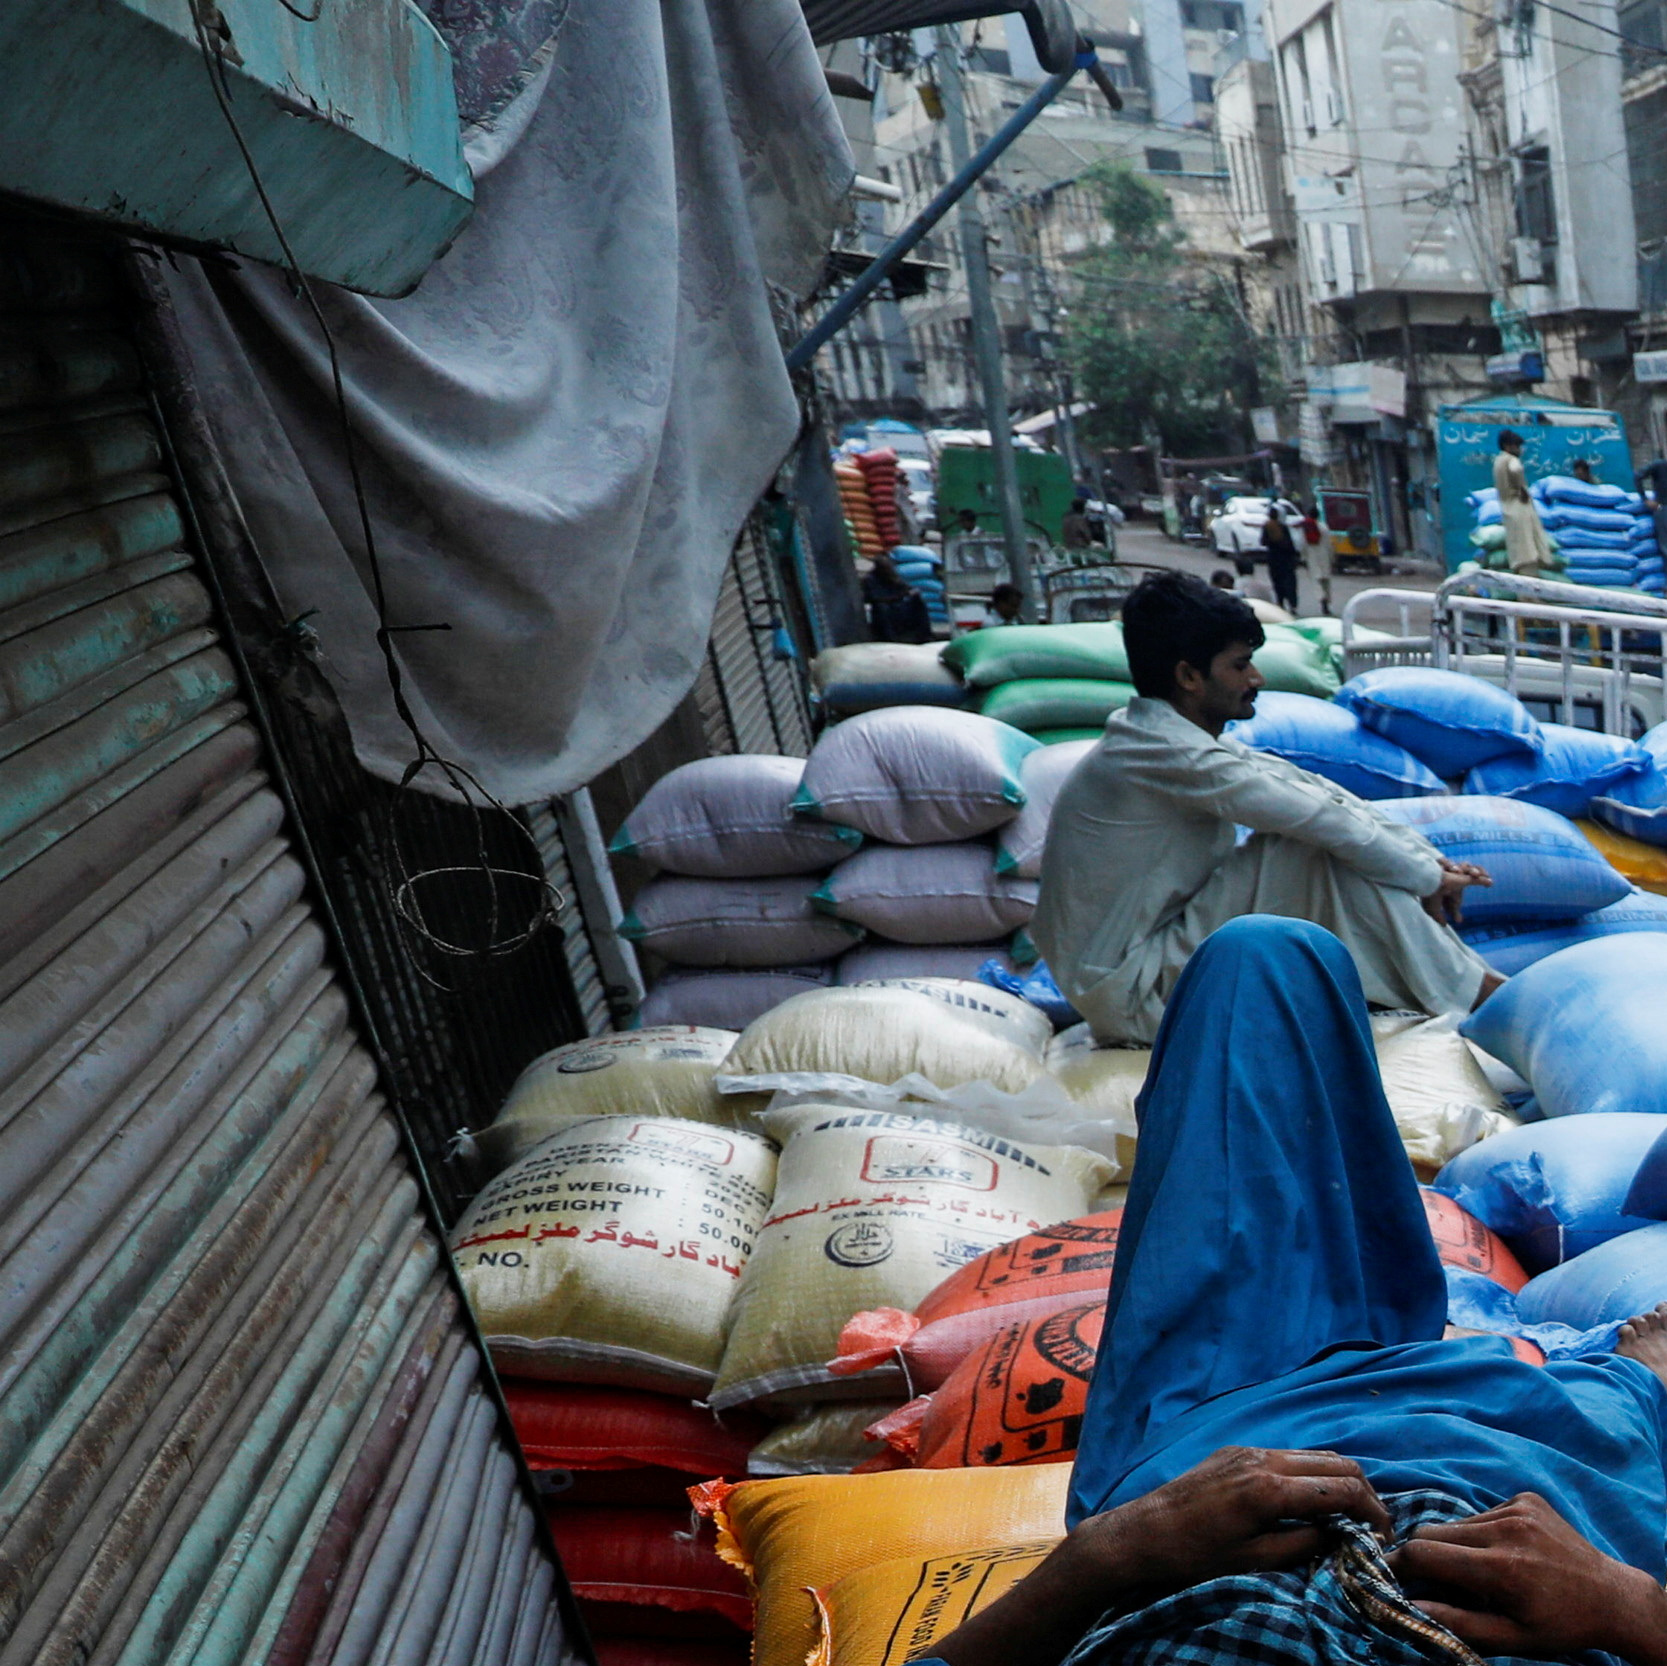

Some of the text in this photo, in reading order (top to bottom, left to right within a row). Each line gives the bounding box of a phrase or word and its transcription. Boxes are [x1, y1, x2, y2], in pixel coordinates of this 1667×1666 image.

[563, 1155, 626, 1173] YEAR
[881, 1164, 974, 1183] STARS
[481, 1182, 561, 1212] GROSS
[567, 1181, 667, 1200] WEIGHT
[486, 1169, 569, 1198] EXPIRY
[473, 1202, 521, 1228] NET
[524, 1199, 624, 1214] WEIGHT
